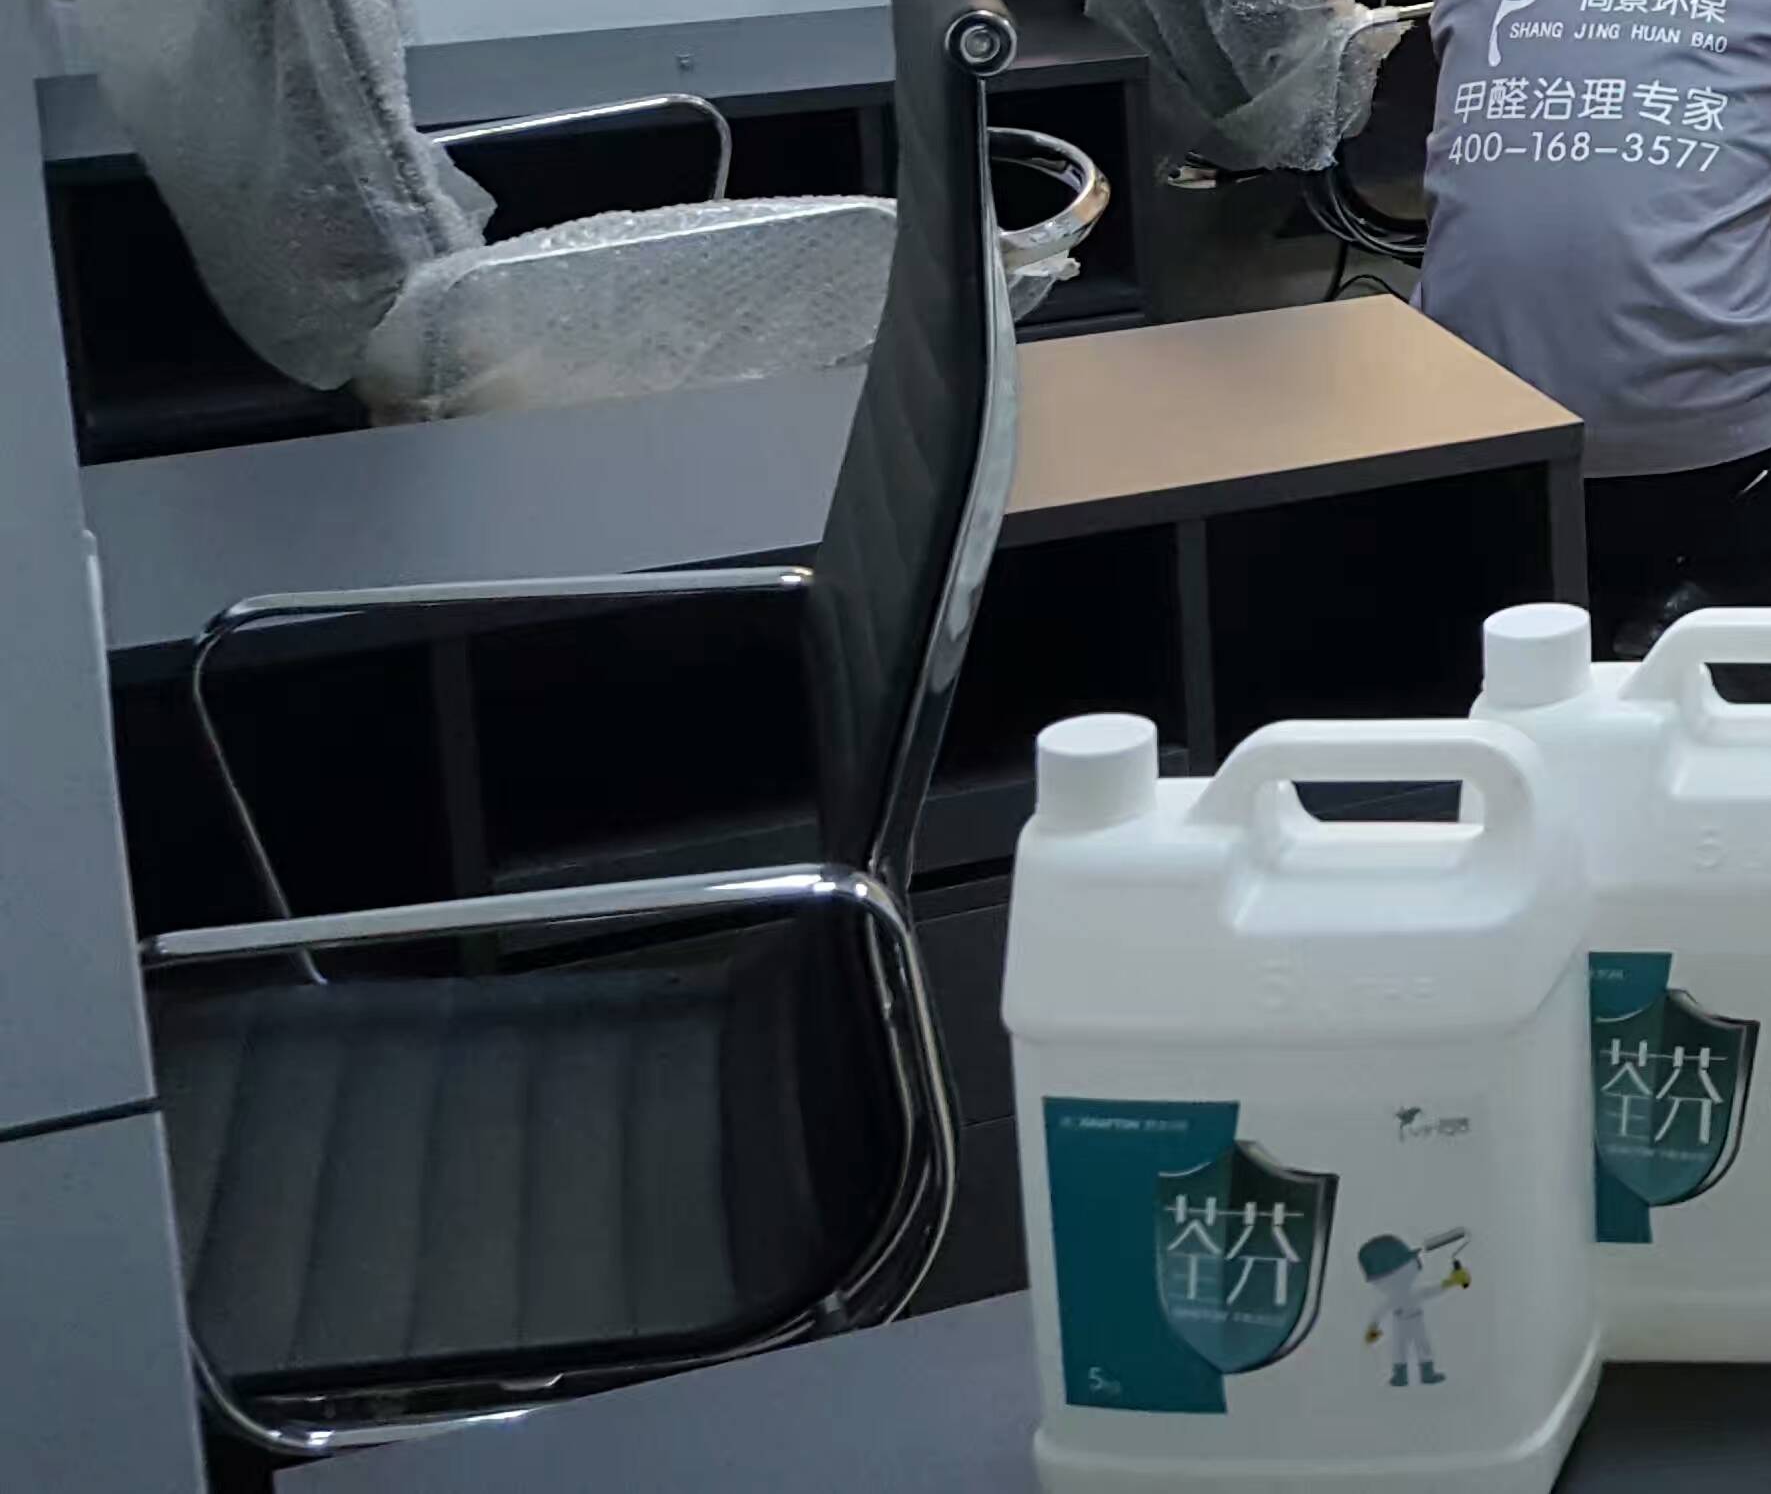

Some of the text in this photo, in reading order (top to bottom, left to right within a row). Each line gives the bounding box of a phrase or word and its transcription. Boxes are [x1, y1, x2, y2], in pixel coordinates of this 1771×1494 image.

[1509, 22, 1728, 53] SHANG JING HUAN BAO
[1454, 77, 1729, 132] 甲醛治理专家
[1448, 131, 1721, 172] 400-168-3577
